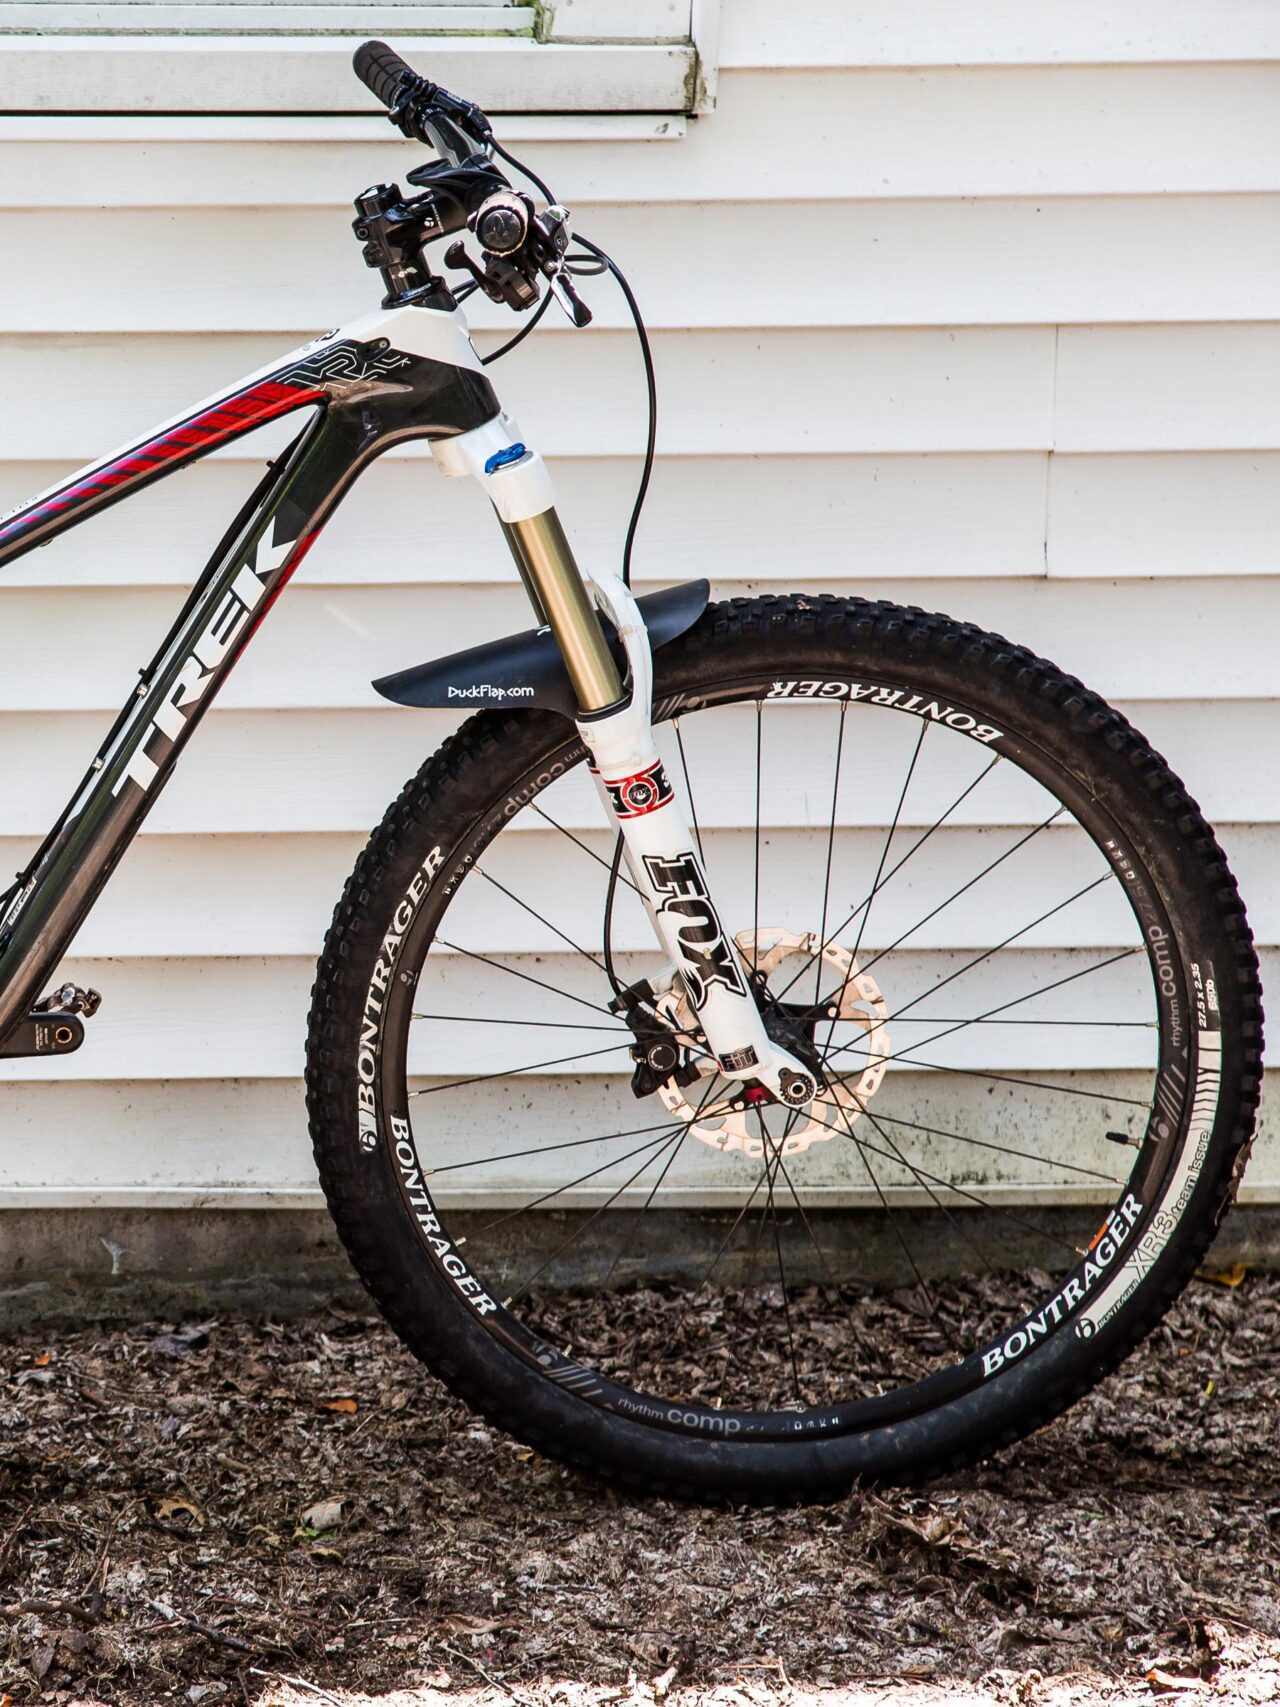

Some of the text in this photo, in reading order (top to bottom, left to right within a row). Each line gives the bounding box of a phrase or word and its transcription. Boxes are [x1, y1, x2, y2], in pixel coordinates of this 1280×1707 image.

[111, 516, 297, 798] TREK
[448, 685, 534, 700] DuckFlap.com
[767, 680, 1004, 743] BONTRAGER
[504, 762, 566, 816] comp
[642, 851, 748, 1011] FOX
[1148, 925, 1177, 997] comp
[357, 845, 446, 1117] BONTRAGER
[1190, 963, 1202, 990] 2.35
[1170, 999, 1184, 1047] rhythm
[1196, 1001, 1207, 1028] 27.5
[390, 1115, 497, 1315] BONTRAGER
[1124, 1209, 1177, 1281] XR3
[1170, 1175, 1197, 1217] team
[1188, 1130, 1211, 1178] issue
[982, 1193, 1143, 1377] BONTRAGER
[618, 1398, 741, 1436] rhythm comp
